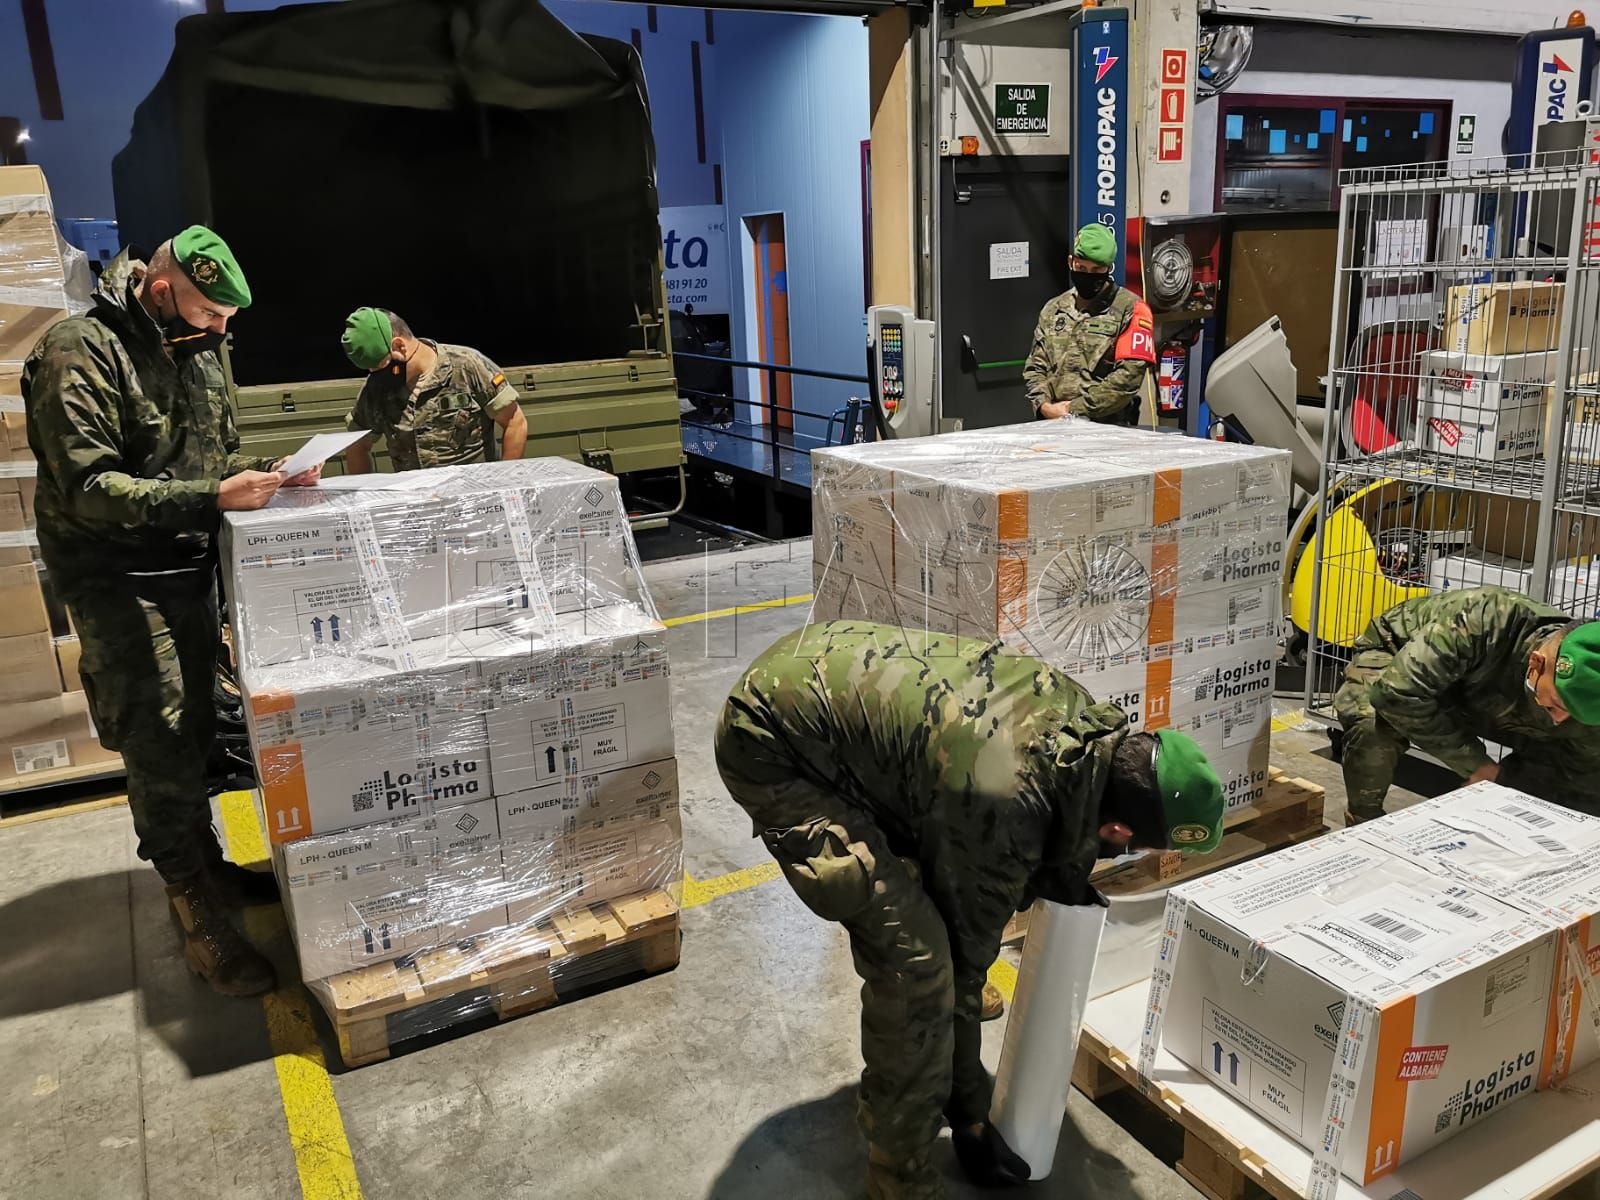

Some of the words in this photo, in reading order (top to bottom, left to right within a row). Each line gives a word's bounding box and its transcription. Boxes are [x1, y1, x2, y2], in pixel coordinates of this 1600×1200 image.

[1007, 88, 1037, 101] SALIDA
[1015, 103, 1027, 115] DE
[996, 117, 1048, 131] EMERGENCIA
[1097, 87, 1116, 207] ROBOPAC
[247, 536, 268, 546] LPH
[275, 530, 310, 543] QUEEN
[312, 529, 321, 539] M
[1222, 541, 1281, 564] Logista
[1222, 559, 1280, 583] Pharma
[1215, 659, 1271, 684] Logista
[1108, 692, 1140, 707] ista
[1214, 677, 1269, 701] Pharma
[597, 738, 613, 748] MUY
[386, 778, 480, 811] Phrma
[1224, 786, 1264, 808] arma
[508, 805, 525, 816] LPH
[532, 798, 561, 811] QUEEN
[299, 853, 320, 865] LPH
[327, 844, 362, 859] QUEEN
[363, 841, 372, 851] M
[1199, 928, 1230, 953] QUEEN
[1231, 946, 1240, 959] M
[1211, 1008, 1230, 1025] VALORA
[1231, 1020, 1243, 1033] ESTE
[1314, 1024, 1338, 1043] exelt
[1402, 1049, 1447, 1064] CONTIENE
[1399, 1062, 1441, 1078] ALBARÁN
[1464, 1050, 1536, 1102] Logista
[1262, 1089, 1291, 1114] FRÁGIL
[1267, 1083, 1286, 1099] MUY
[1459, 1074, 1532, 1126] Pharma
